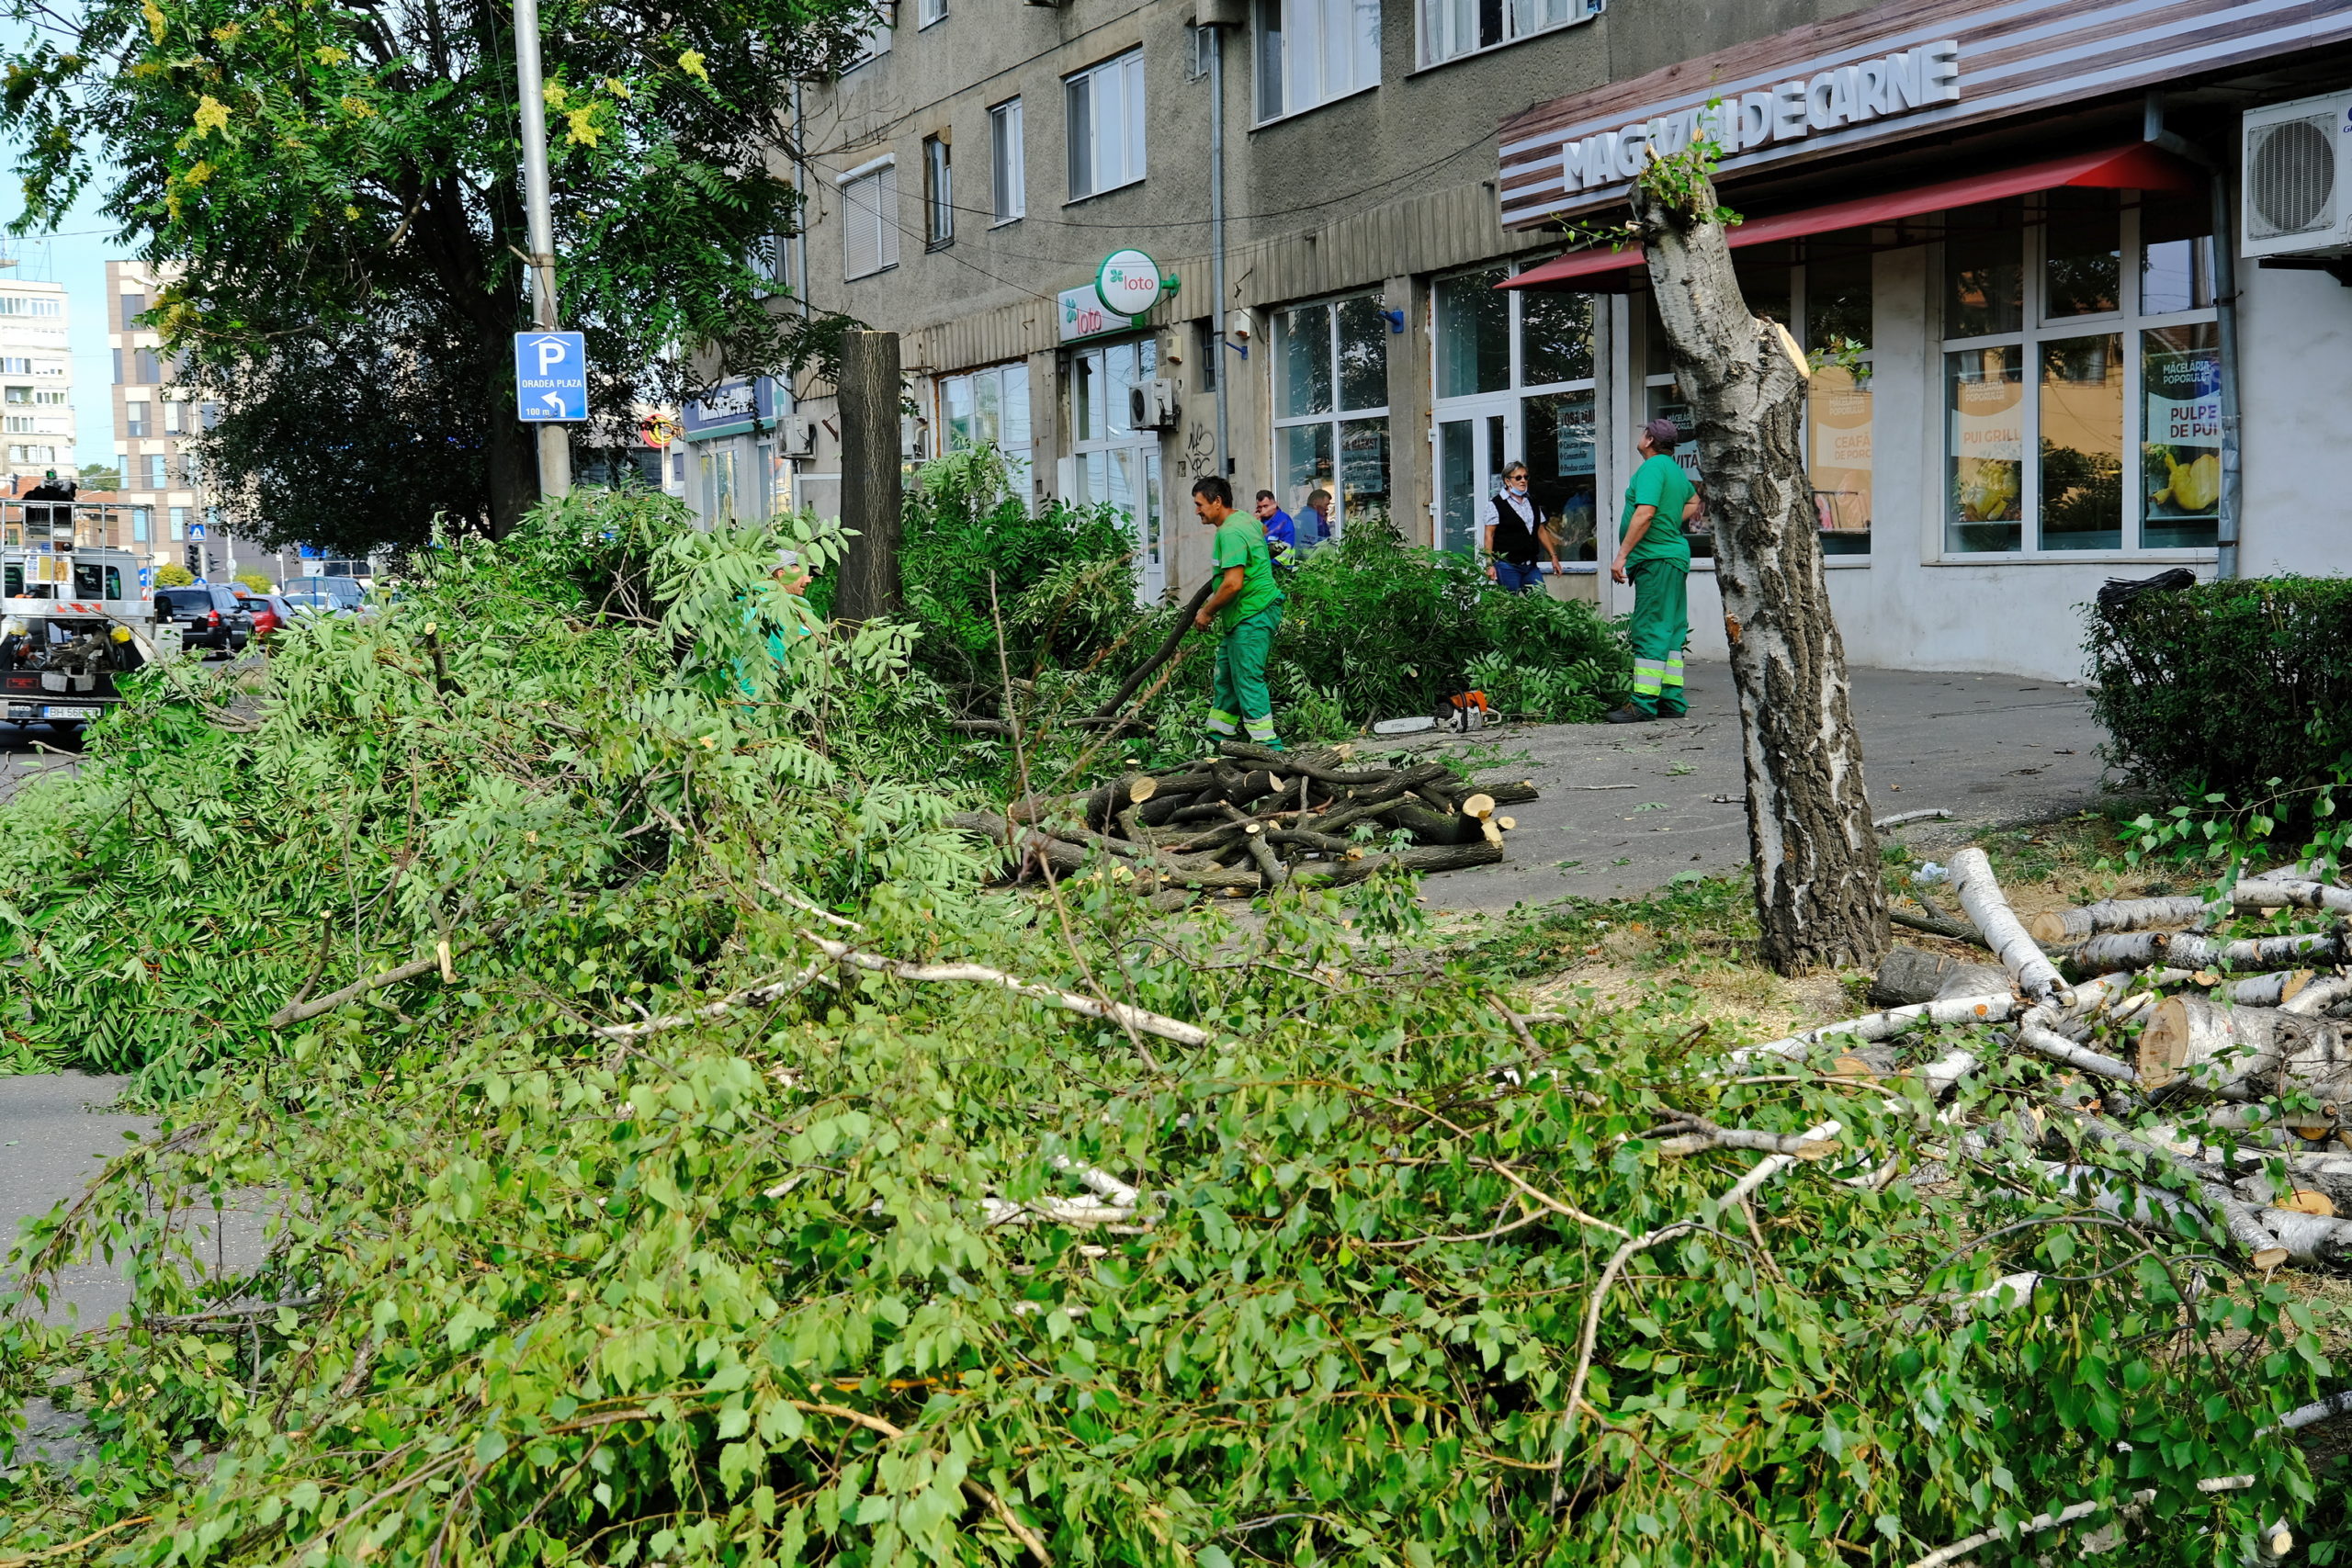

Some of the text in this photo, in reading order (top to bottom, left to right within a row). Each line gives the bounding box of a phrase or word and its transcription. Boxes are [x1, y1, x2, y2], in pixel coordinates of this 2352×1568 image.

[1742, 81, 1807, 148] DE
[1806, 40, 1960, 130] CARNE
[1125, 276, 1154, 290] loto
[1077, 308, 1102, 334] loto
[538, 343, 565, 376] P
[522, 379, 582, 388] ORADEA PLAZA
[526, 408, 540, 416] 100
[2171, 405, 2217, 421] PULPE
[1963, 428, 2019, 444] PUI GRILL
[2171, 423, 2217, 438] DE PUI
[1835, 432, 1871, 448] CEAFĂ
[1835, 449, 1871, 460] DE PORC
[50, 708, 64, 716] BH
